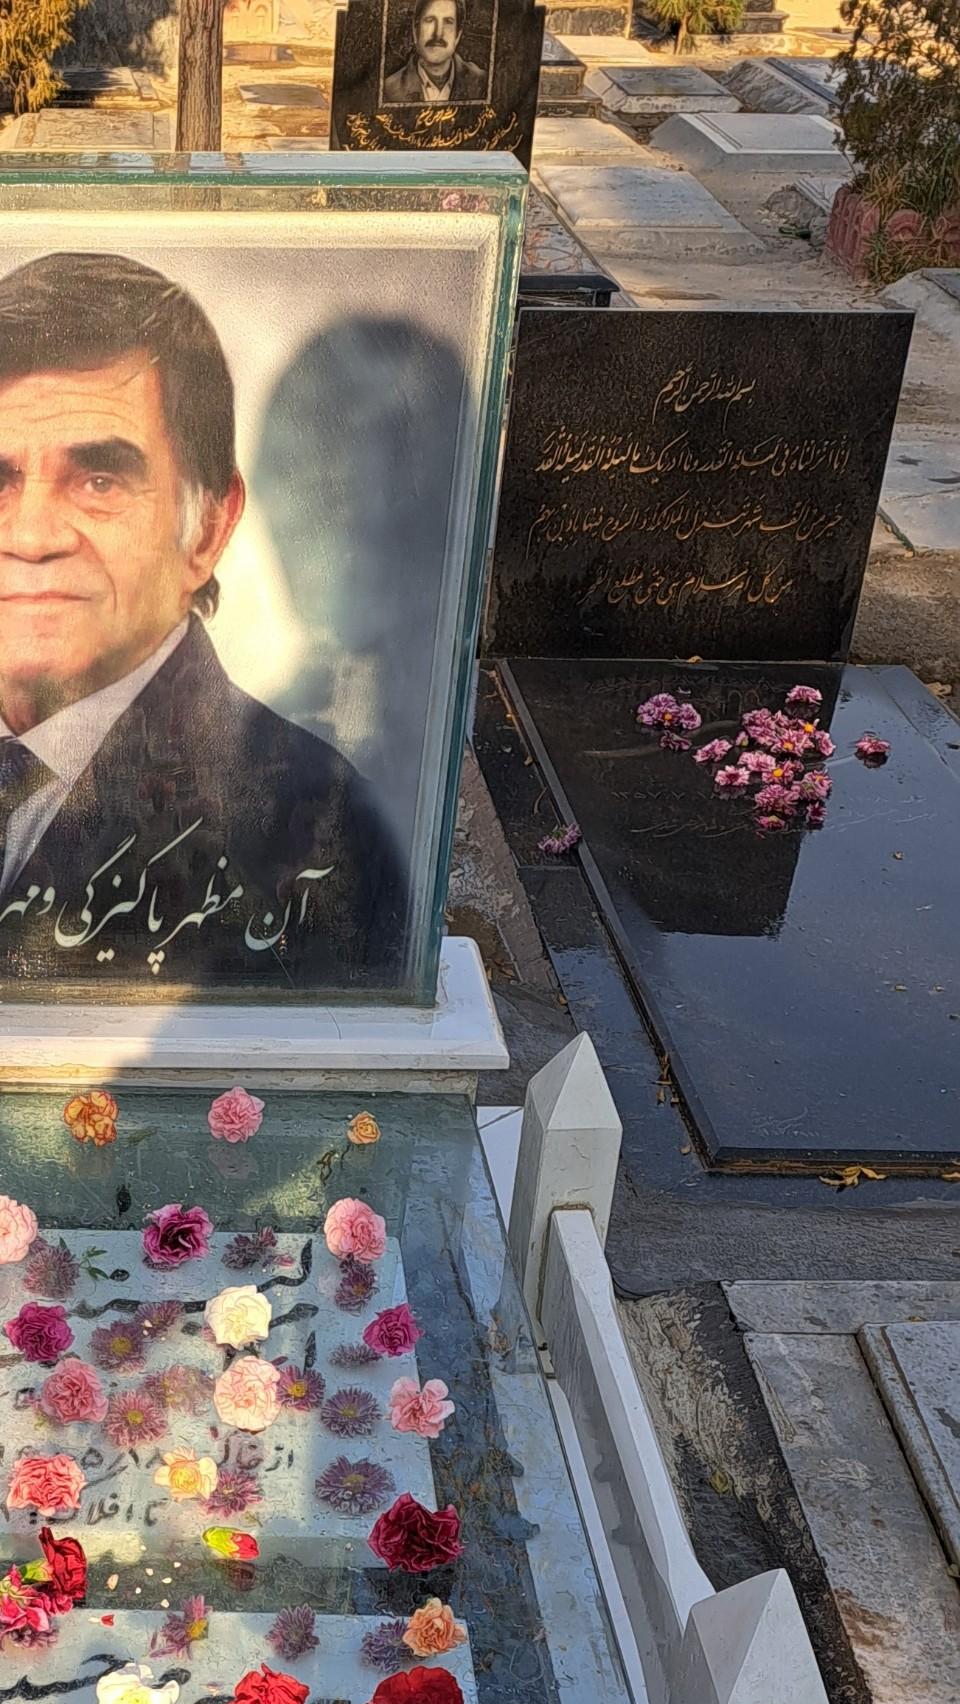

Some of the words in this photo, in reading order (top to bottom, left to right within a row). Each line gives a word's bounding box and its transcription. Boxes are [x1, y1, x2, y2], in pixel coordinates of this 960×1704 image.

[53, 815, 203, 976] پاکیزگی
[153, 855, 244, 950] مظهر
[244, 865, 336, 951] آن
